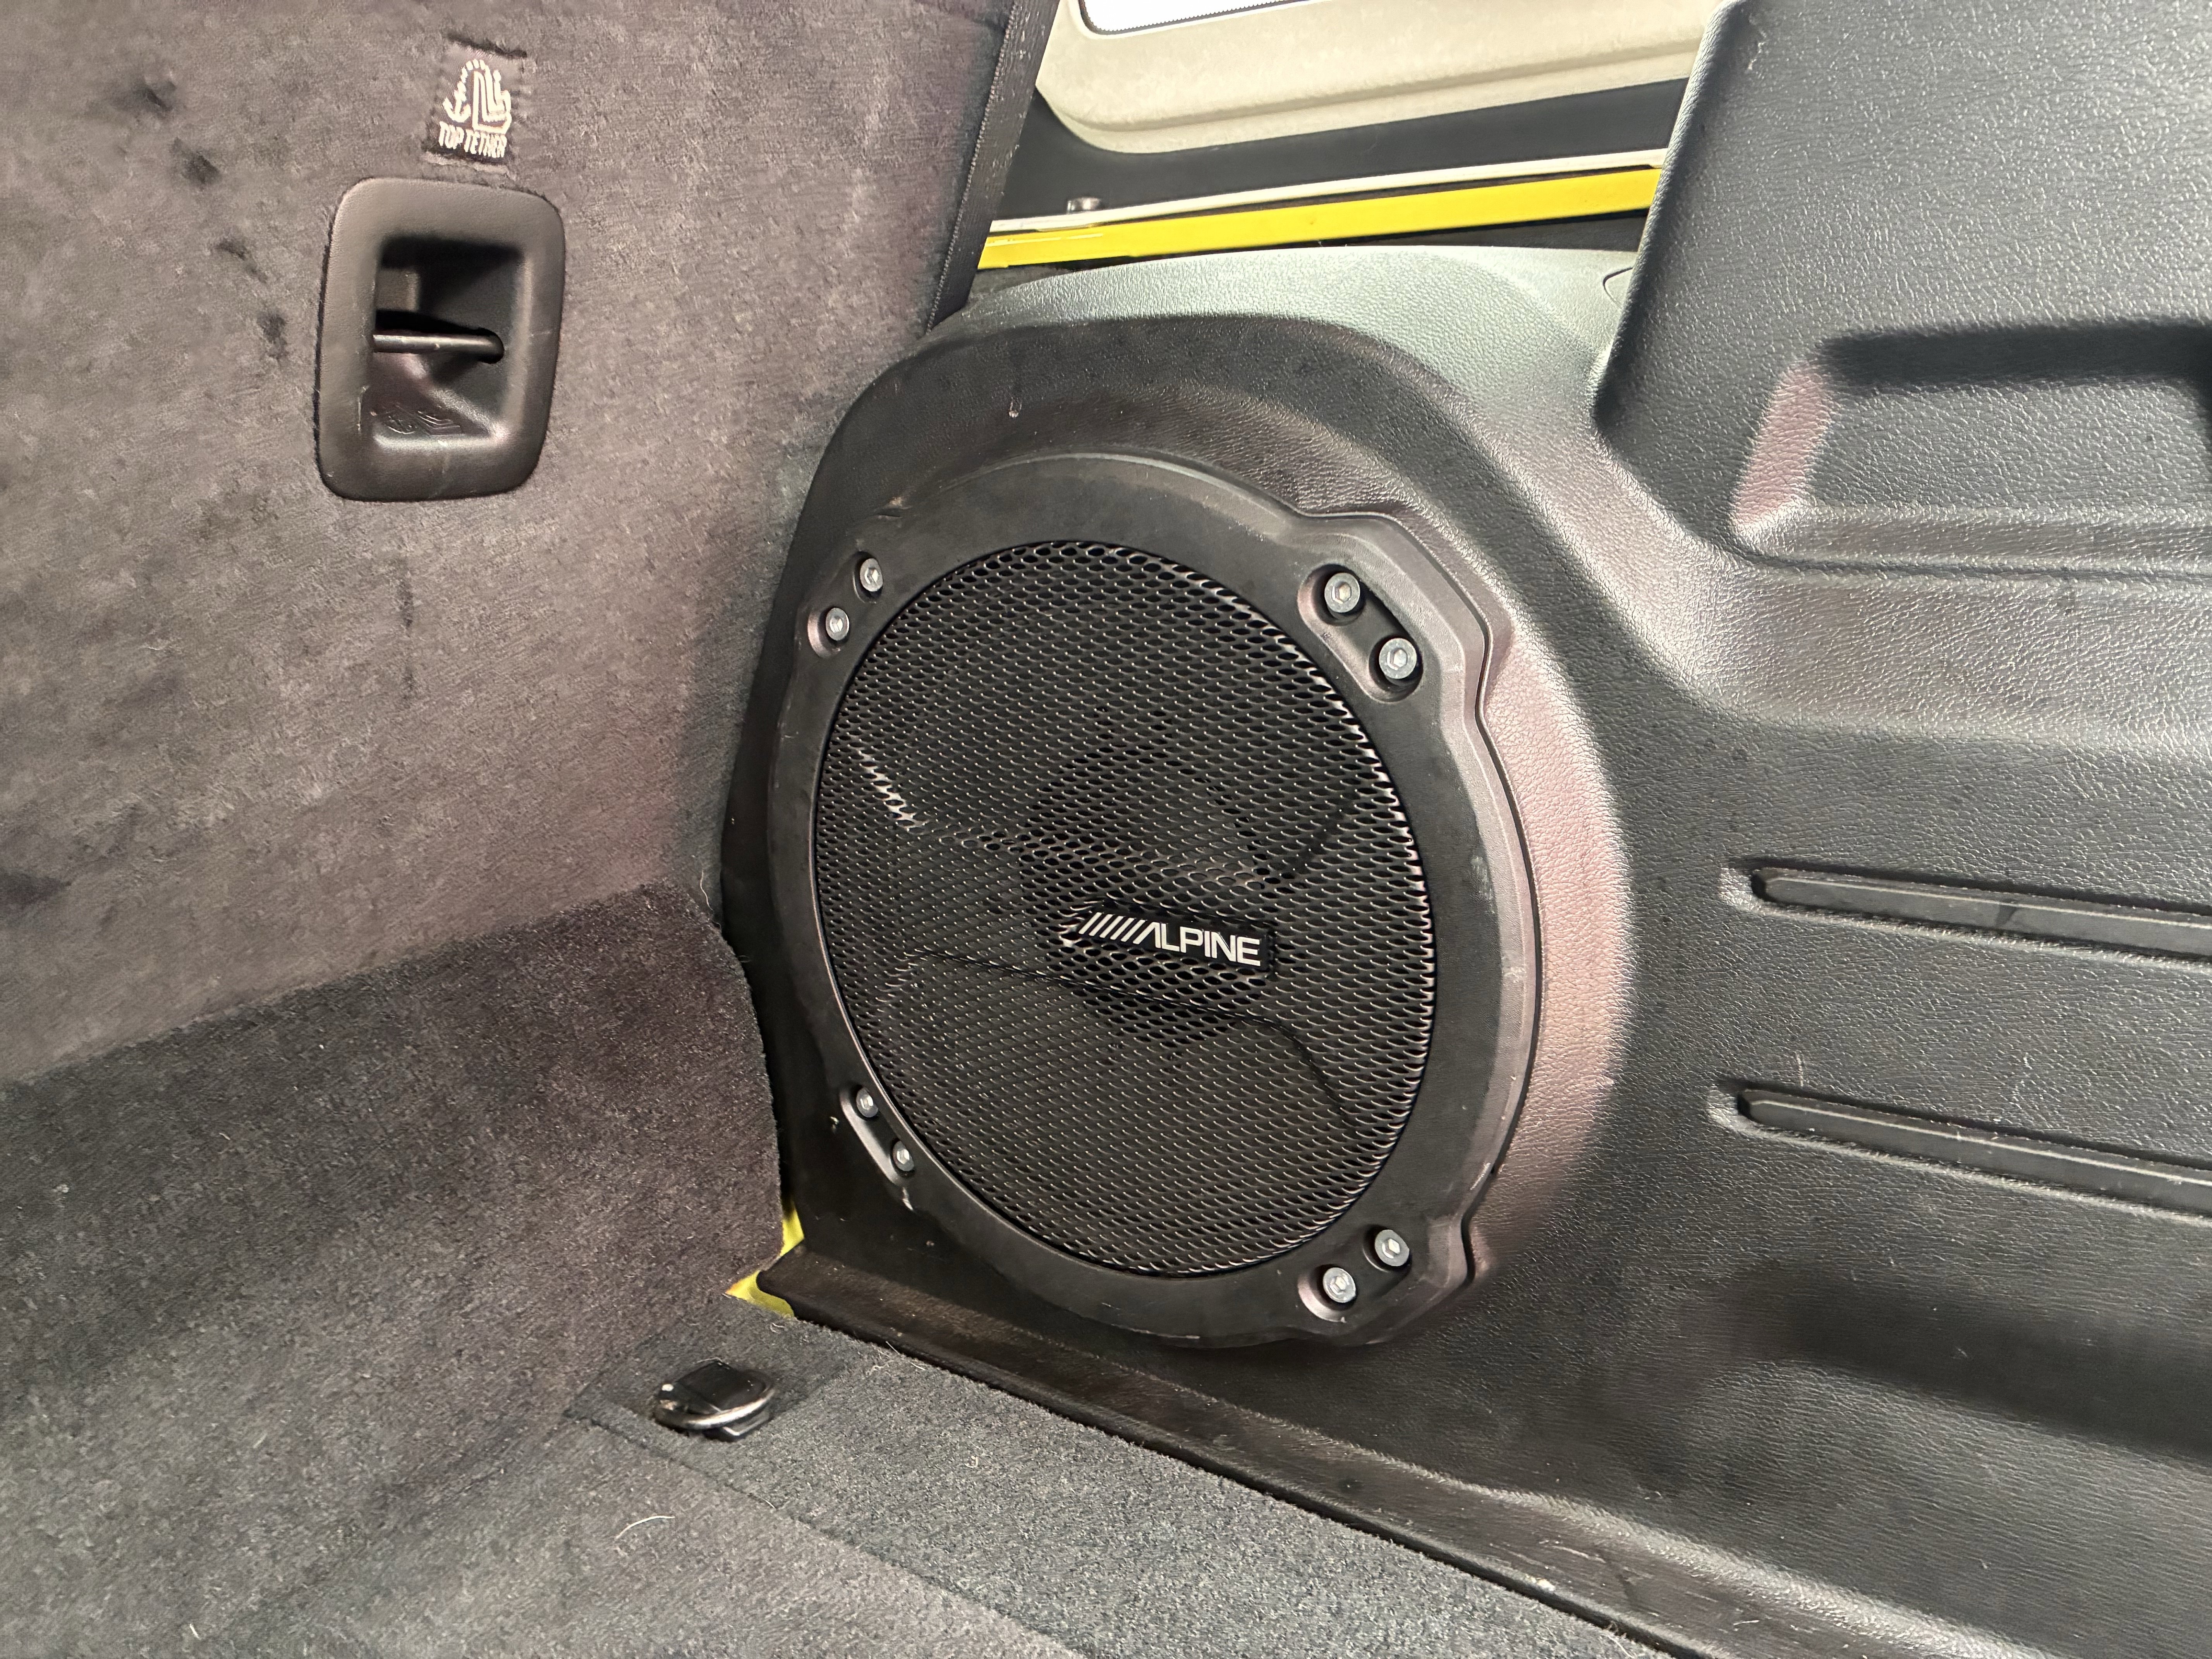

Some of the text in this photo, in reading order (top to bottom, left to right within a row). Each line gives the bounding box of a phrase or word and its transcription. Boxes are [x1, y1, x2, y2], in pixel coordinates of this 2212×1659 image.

[438, 121, 507, 158] TOP TETHER
[1132, 922, 1261, 966] ALPINE
